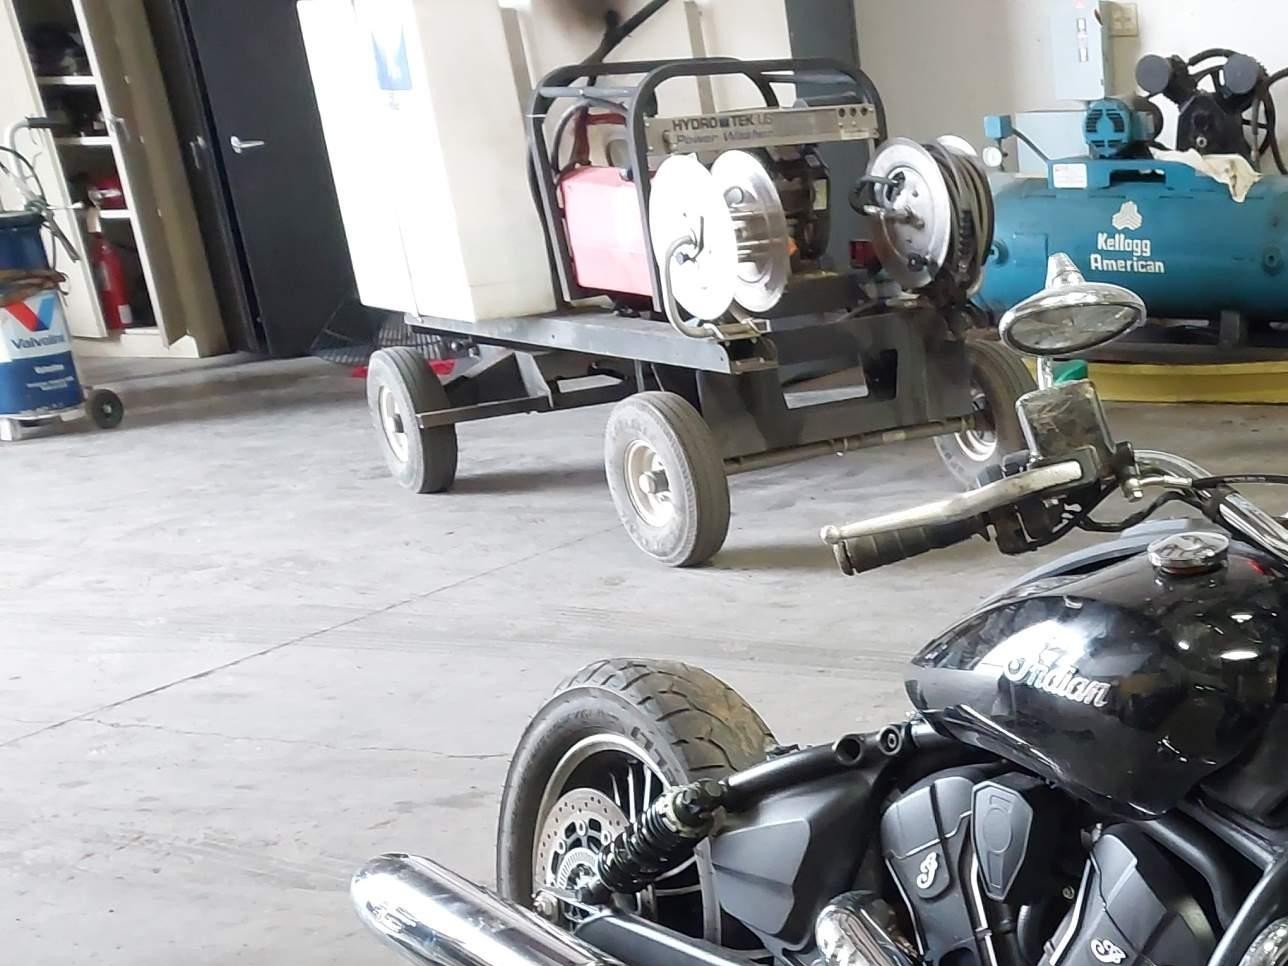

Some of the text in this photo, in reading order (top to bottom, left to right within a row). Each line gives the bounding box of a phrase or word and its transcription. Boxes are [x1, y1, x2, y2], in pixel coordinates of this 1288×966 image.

[672, 116, 717, 131] HYDRO
[730, 115, 754, 128] TEK
[1097, 232, 1151, 257] Kellogg
[1090, 253, 1165, 273] American
[1003, 642, 1111, 708] Indian
